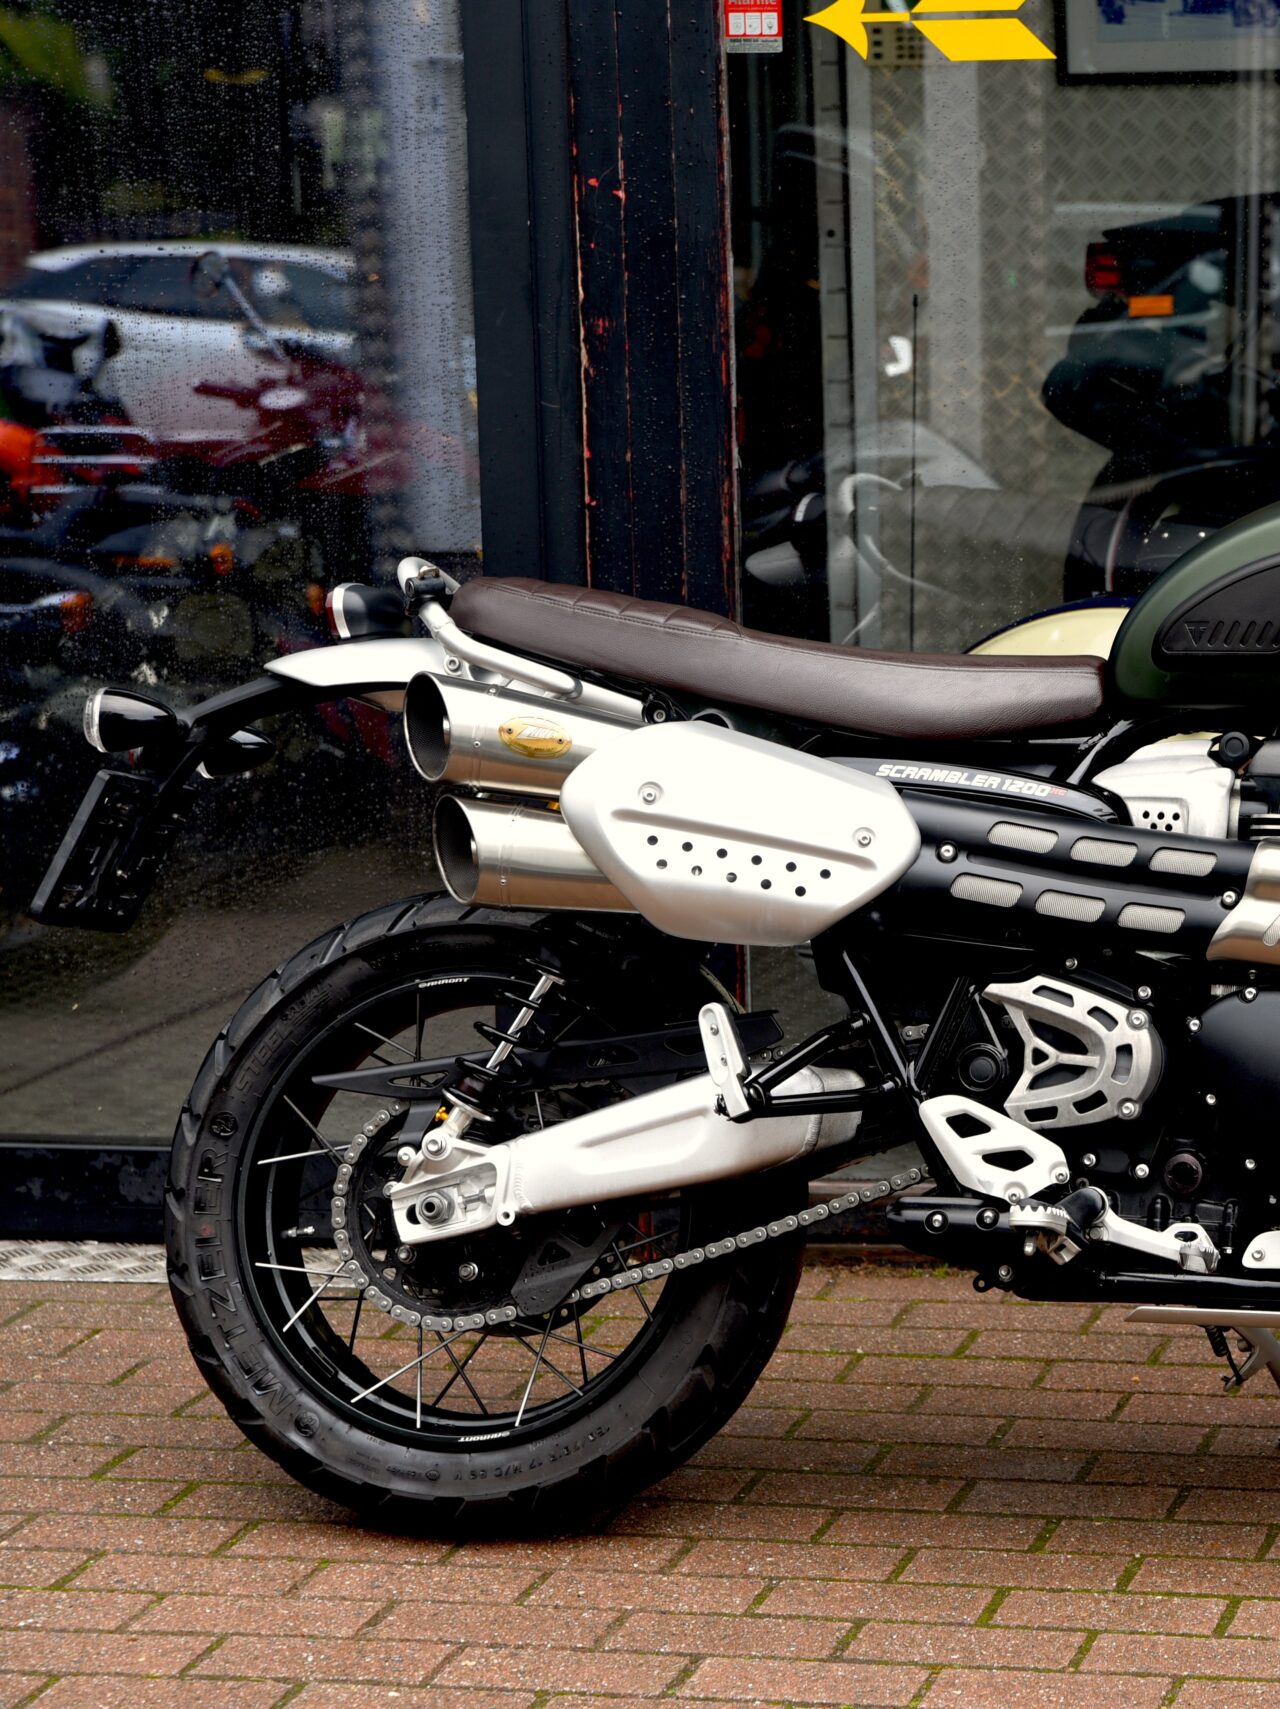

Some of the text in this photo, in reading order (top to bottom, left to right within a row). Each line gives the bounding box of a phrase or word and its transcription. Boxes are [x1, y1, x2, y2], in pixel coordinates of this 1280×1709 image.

[875, 764, 1001, 789] SCRAMBLER
[1001, 779, 1051, 797] 1200
[234, 1022, 294, 1092] STEEL
[194, 1148, 297, 1416] METZELER
